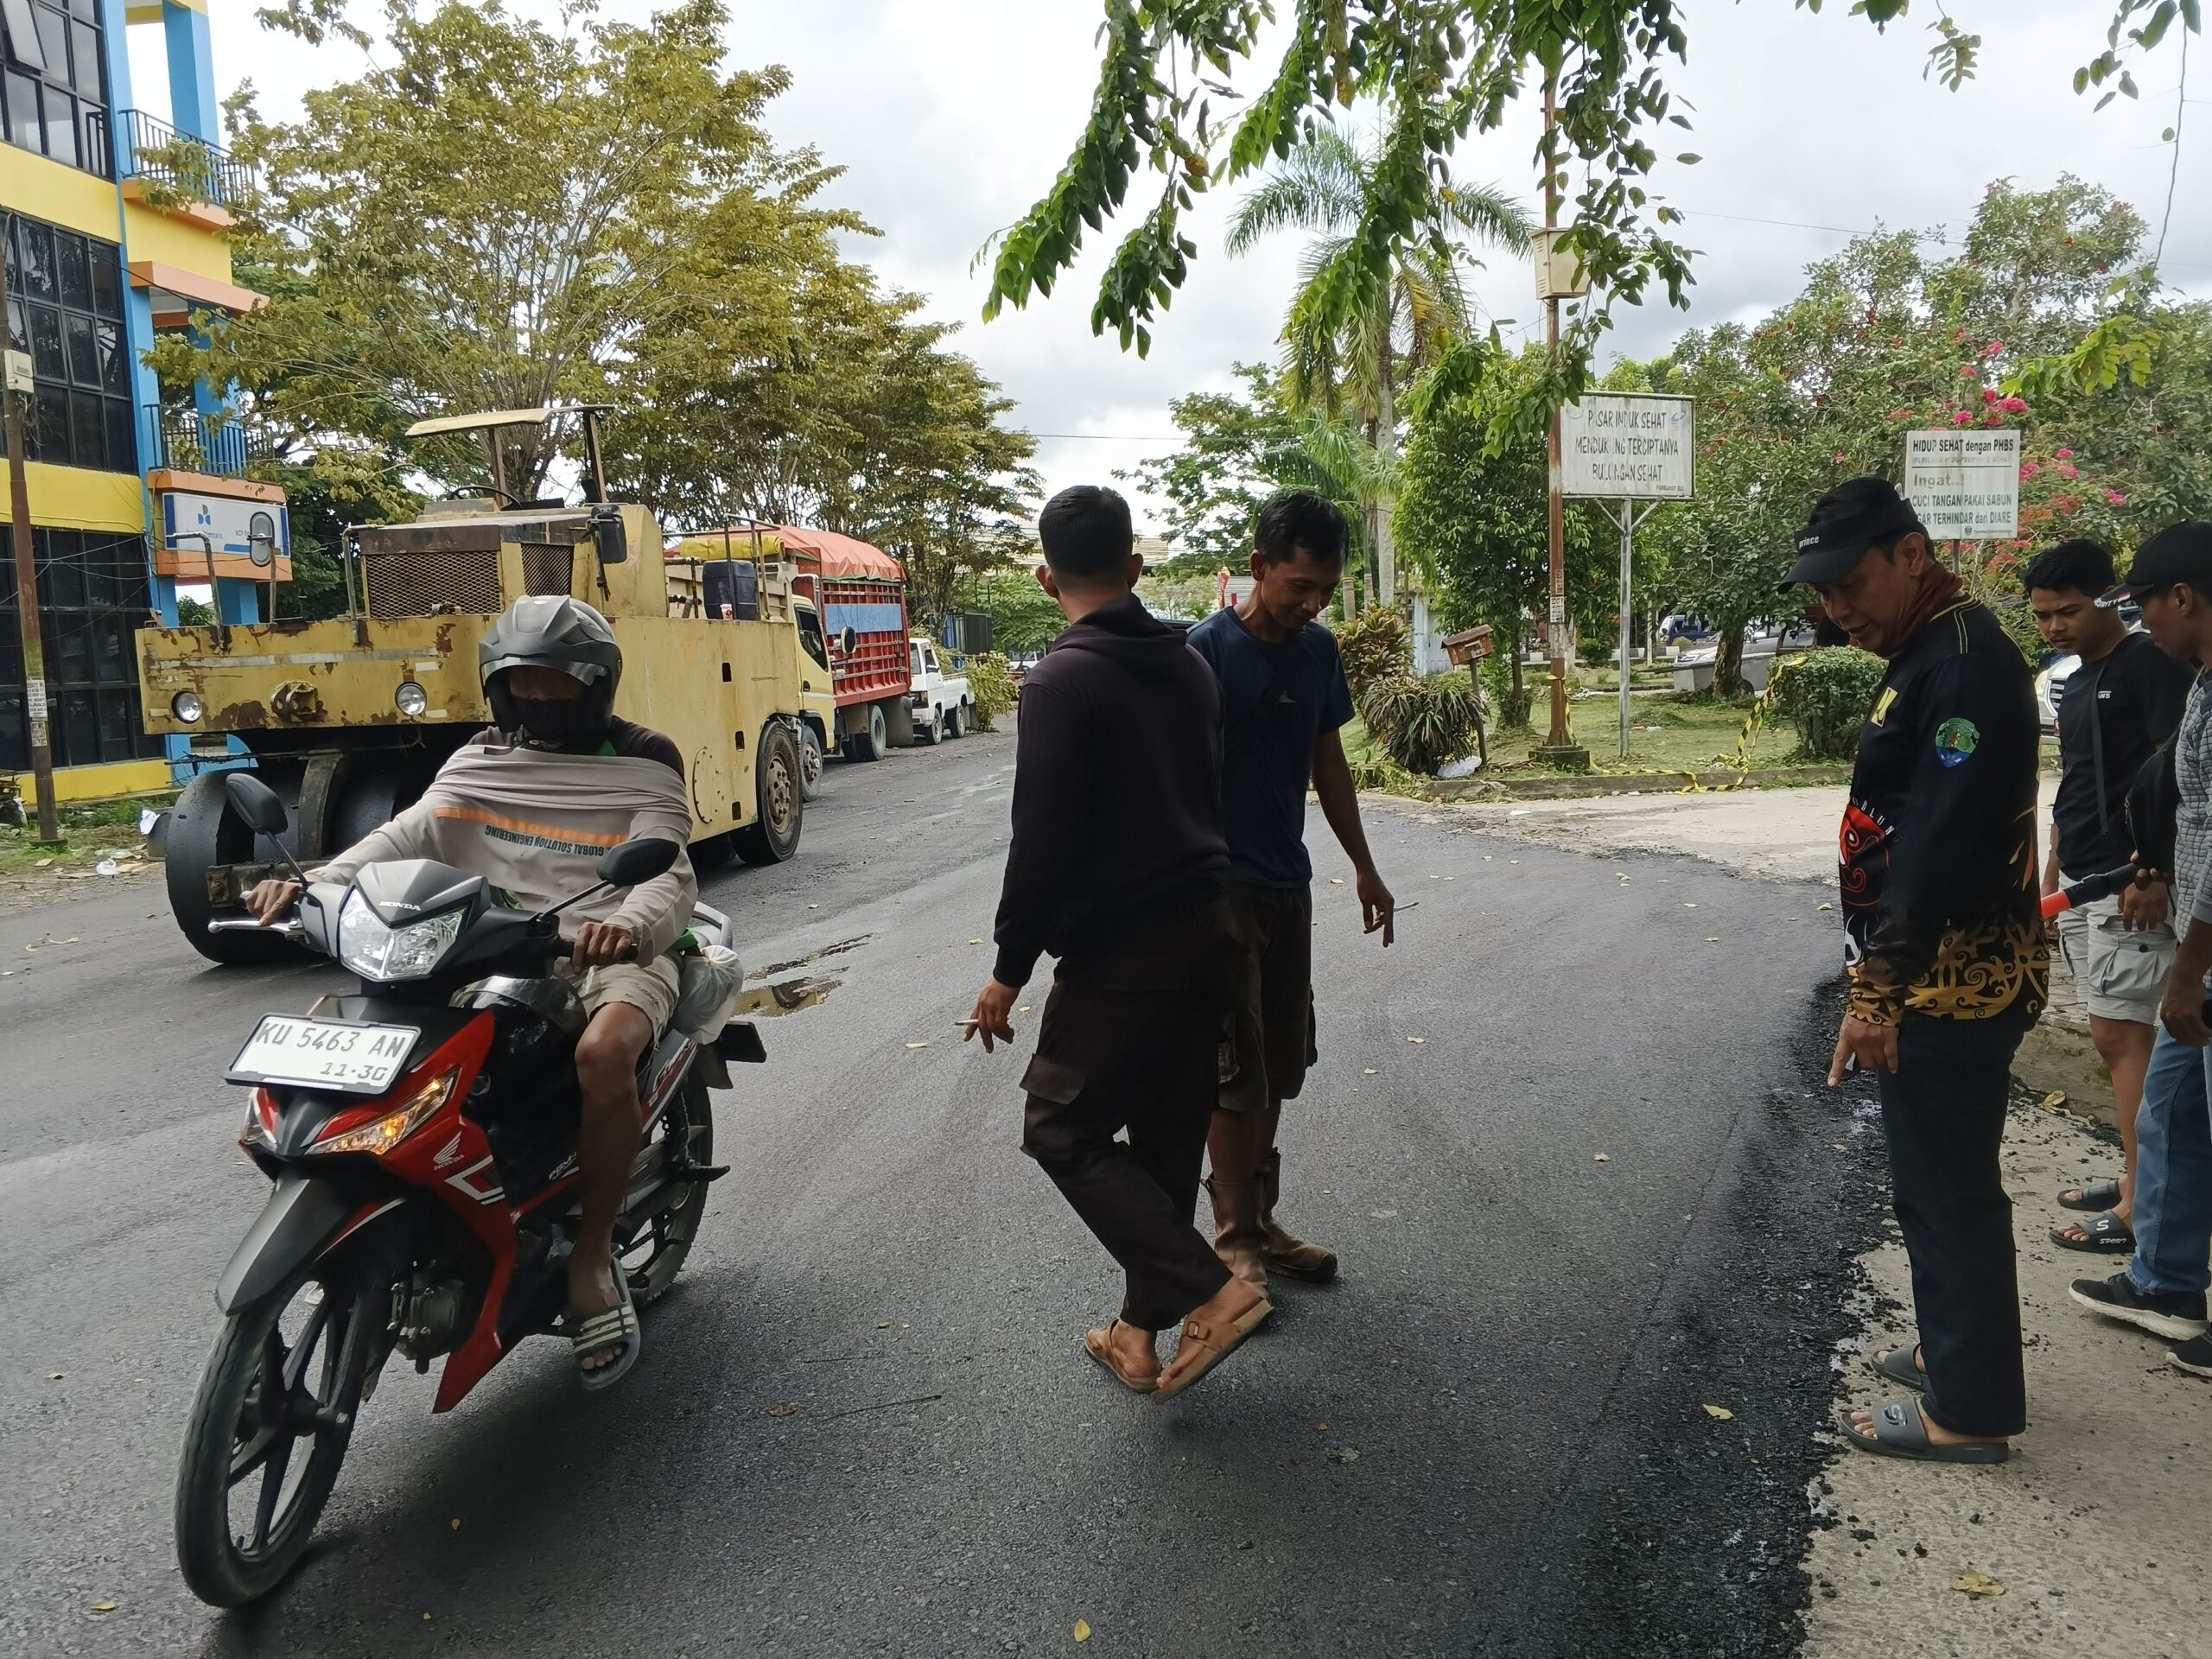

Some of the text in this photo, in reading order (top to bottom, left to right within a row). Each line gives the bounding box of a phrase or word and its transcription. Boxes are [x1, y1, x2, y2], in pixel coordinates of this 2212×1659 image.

[1588, 410, 1613, 428] PSAR
[1641, 411, 1667, 429] SEHAT
[1576, 435, 1679, 456] MENDUKNG TERCIPTANYA
[1913, 438, 2013, 454] HIDUP SEHAT dengan PHBS
[1637, 464, 1662, 481] SEHAT
[1912, 493, 2012, 507] CUCI TANGAN PAKAI SABUN
[1916, 511, 2012, 525] GAR TERHINDAR dari DIARE
[2098, 690, 2112, 699] ANS
[485, 824, 605, 857] GLOBAL SOLUTION ENGINEERING
[378, 900, 422, 912] HONDA
[256, 1022, 406, 1058] KU 5463 AN
